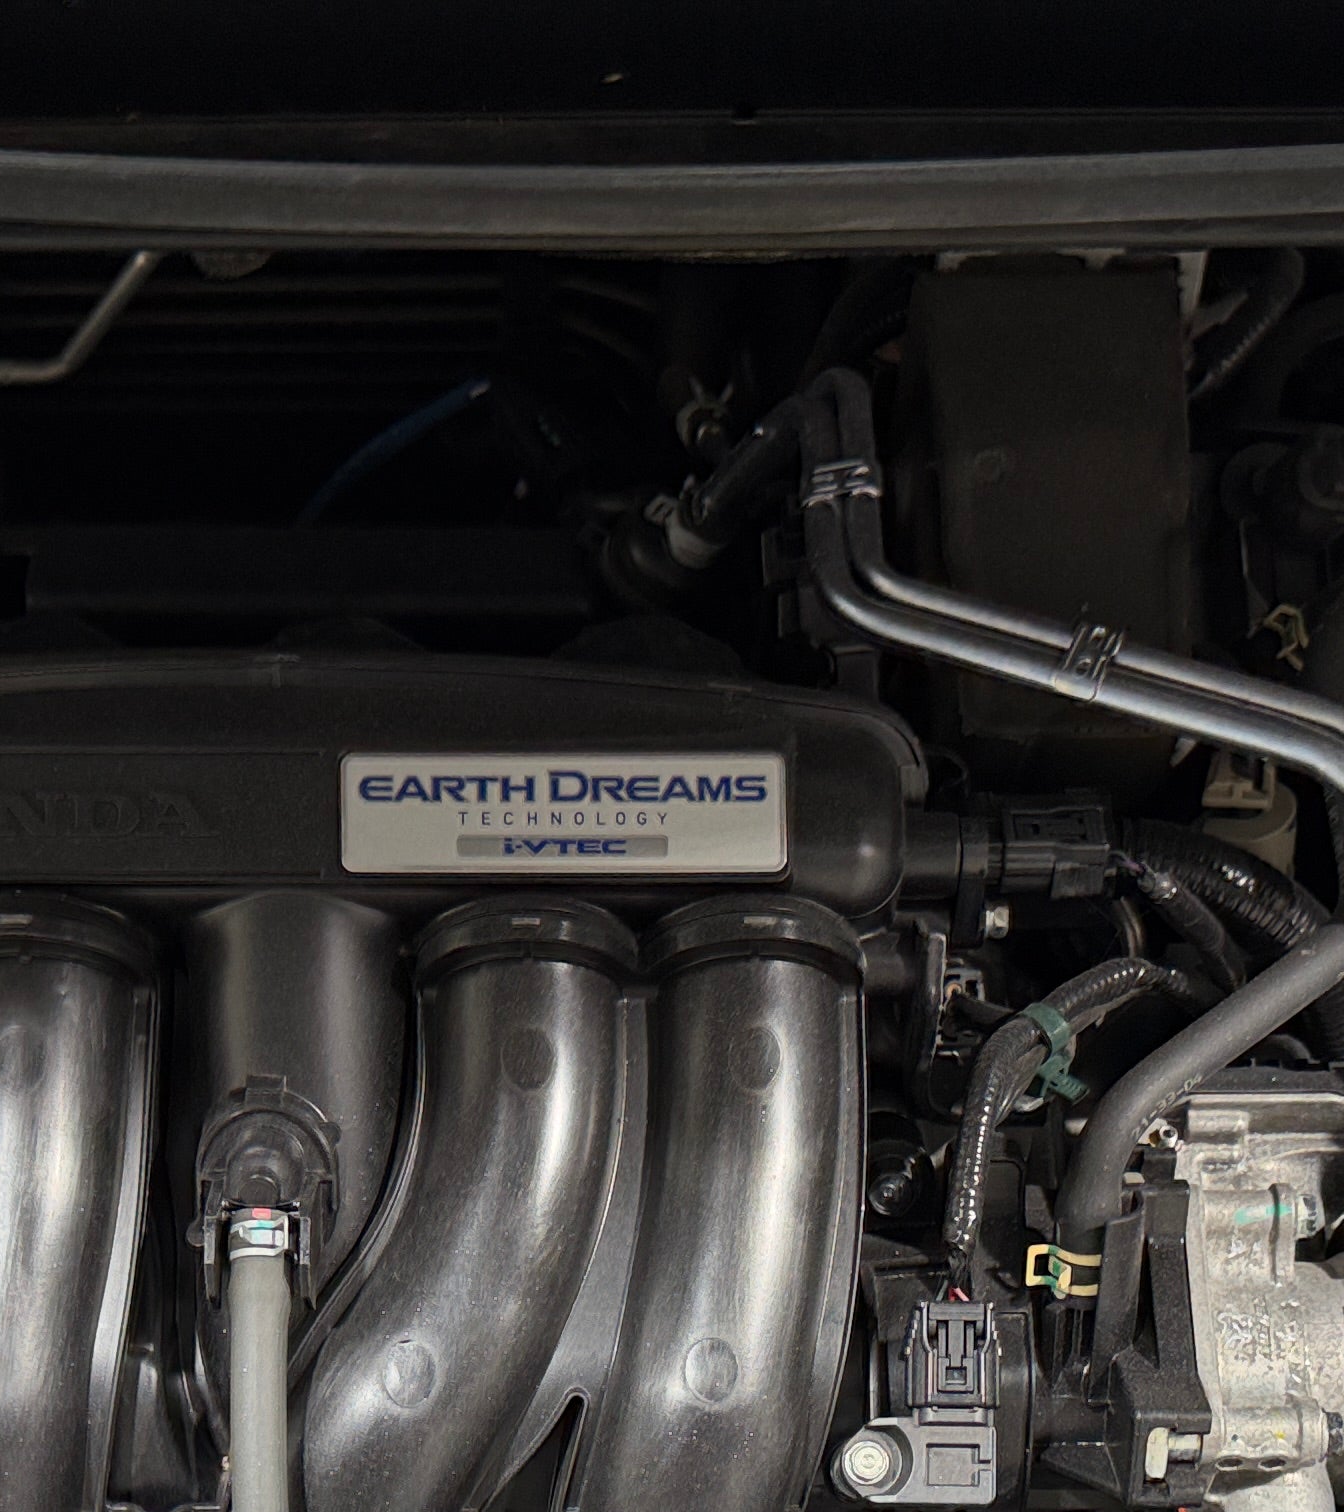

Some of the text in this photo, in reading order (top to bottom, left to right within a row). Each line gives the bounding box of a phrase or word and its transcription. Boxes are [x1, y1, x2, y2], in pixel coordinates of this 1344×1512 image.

[359, 770, 768, 803] EARTH DREAMS
[458, 811, 668, 826] TECHNOLOGY
[503, 838, 627, 856] i-VTEC
